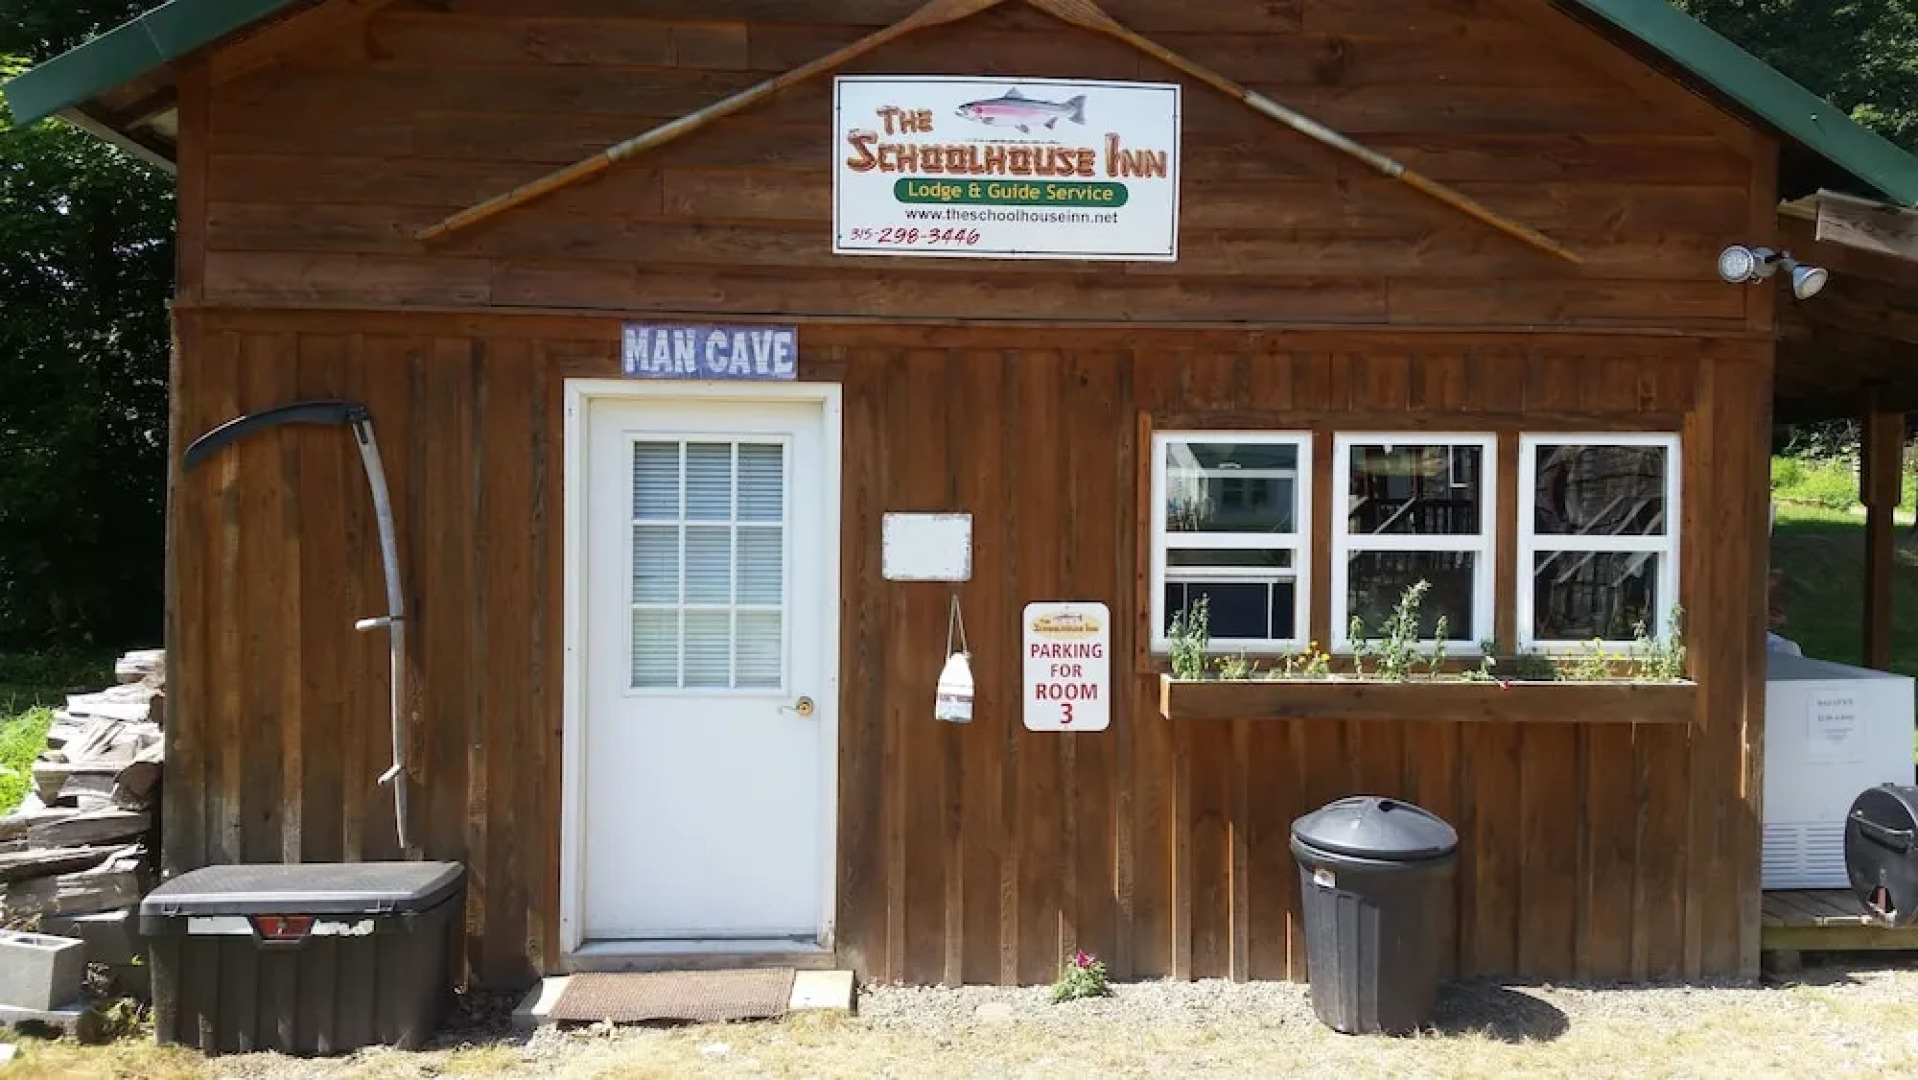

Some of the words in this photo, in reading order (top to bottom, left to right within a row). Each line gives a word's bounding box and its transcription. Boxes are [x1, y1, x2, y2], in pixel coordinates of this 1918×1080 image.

[877, 106, 934, 134] THE
[847, 129, 1096, 178] SCHOOLHOUSE
[1105, 132, 1168, 178] INN
[908, 181, 962, 199] Lodge
[968, 182, 981, 197] &
[987, 183, 1040, 200] Guide
[1046, 183, 1115, 201] Service
[905, 208, 1119, 224] www.theschoolhouseinn.net
[624, 328, 697, 374] MAN
[705, 329, 793, 375] CAVE
[1030, 643, 1103, 659] PARKING
[1050, 663, 1083, 678] FOR
[1035, 682, 1098, 700] ROOM
[1060, 703, 1073, 724] 3
